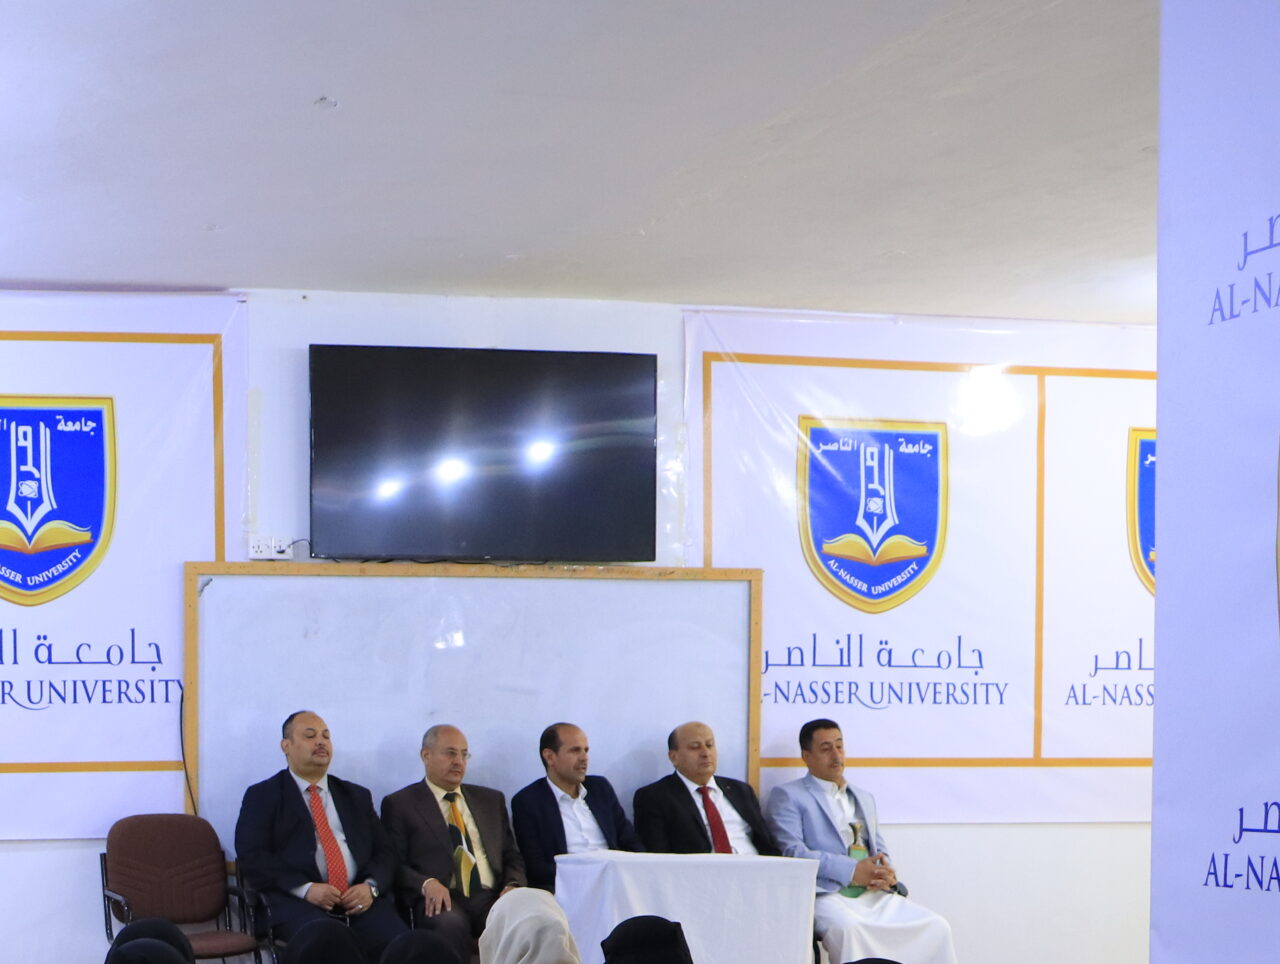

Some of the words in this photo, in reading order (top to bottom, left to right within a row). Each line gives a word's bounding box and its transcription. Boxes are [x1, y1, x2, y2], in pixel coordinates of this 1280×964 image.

[55, 415, 97, 436] جامعة
[898, 437, 933, 458] جامعة
[26, 548, 82, 586] UNIVERSITY
[827, 558, 869, 593] AL-NASSER
[871, 561, 919, 595] UNIVERSITY
[33, 627, 163, 672] جامعة
[876, 634, 984, 676] جامعة
[761, 680, 888, 710] -NASSER
[869, 681, 1009, 706] UNIVERSITY
[1064, 683, 1155, 706] AL-NASS
[1202, 851, 1280, 893] AL-NA
